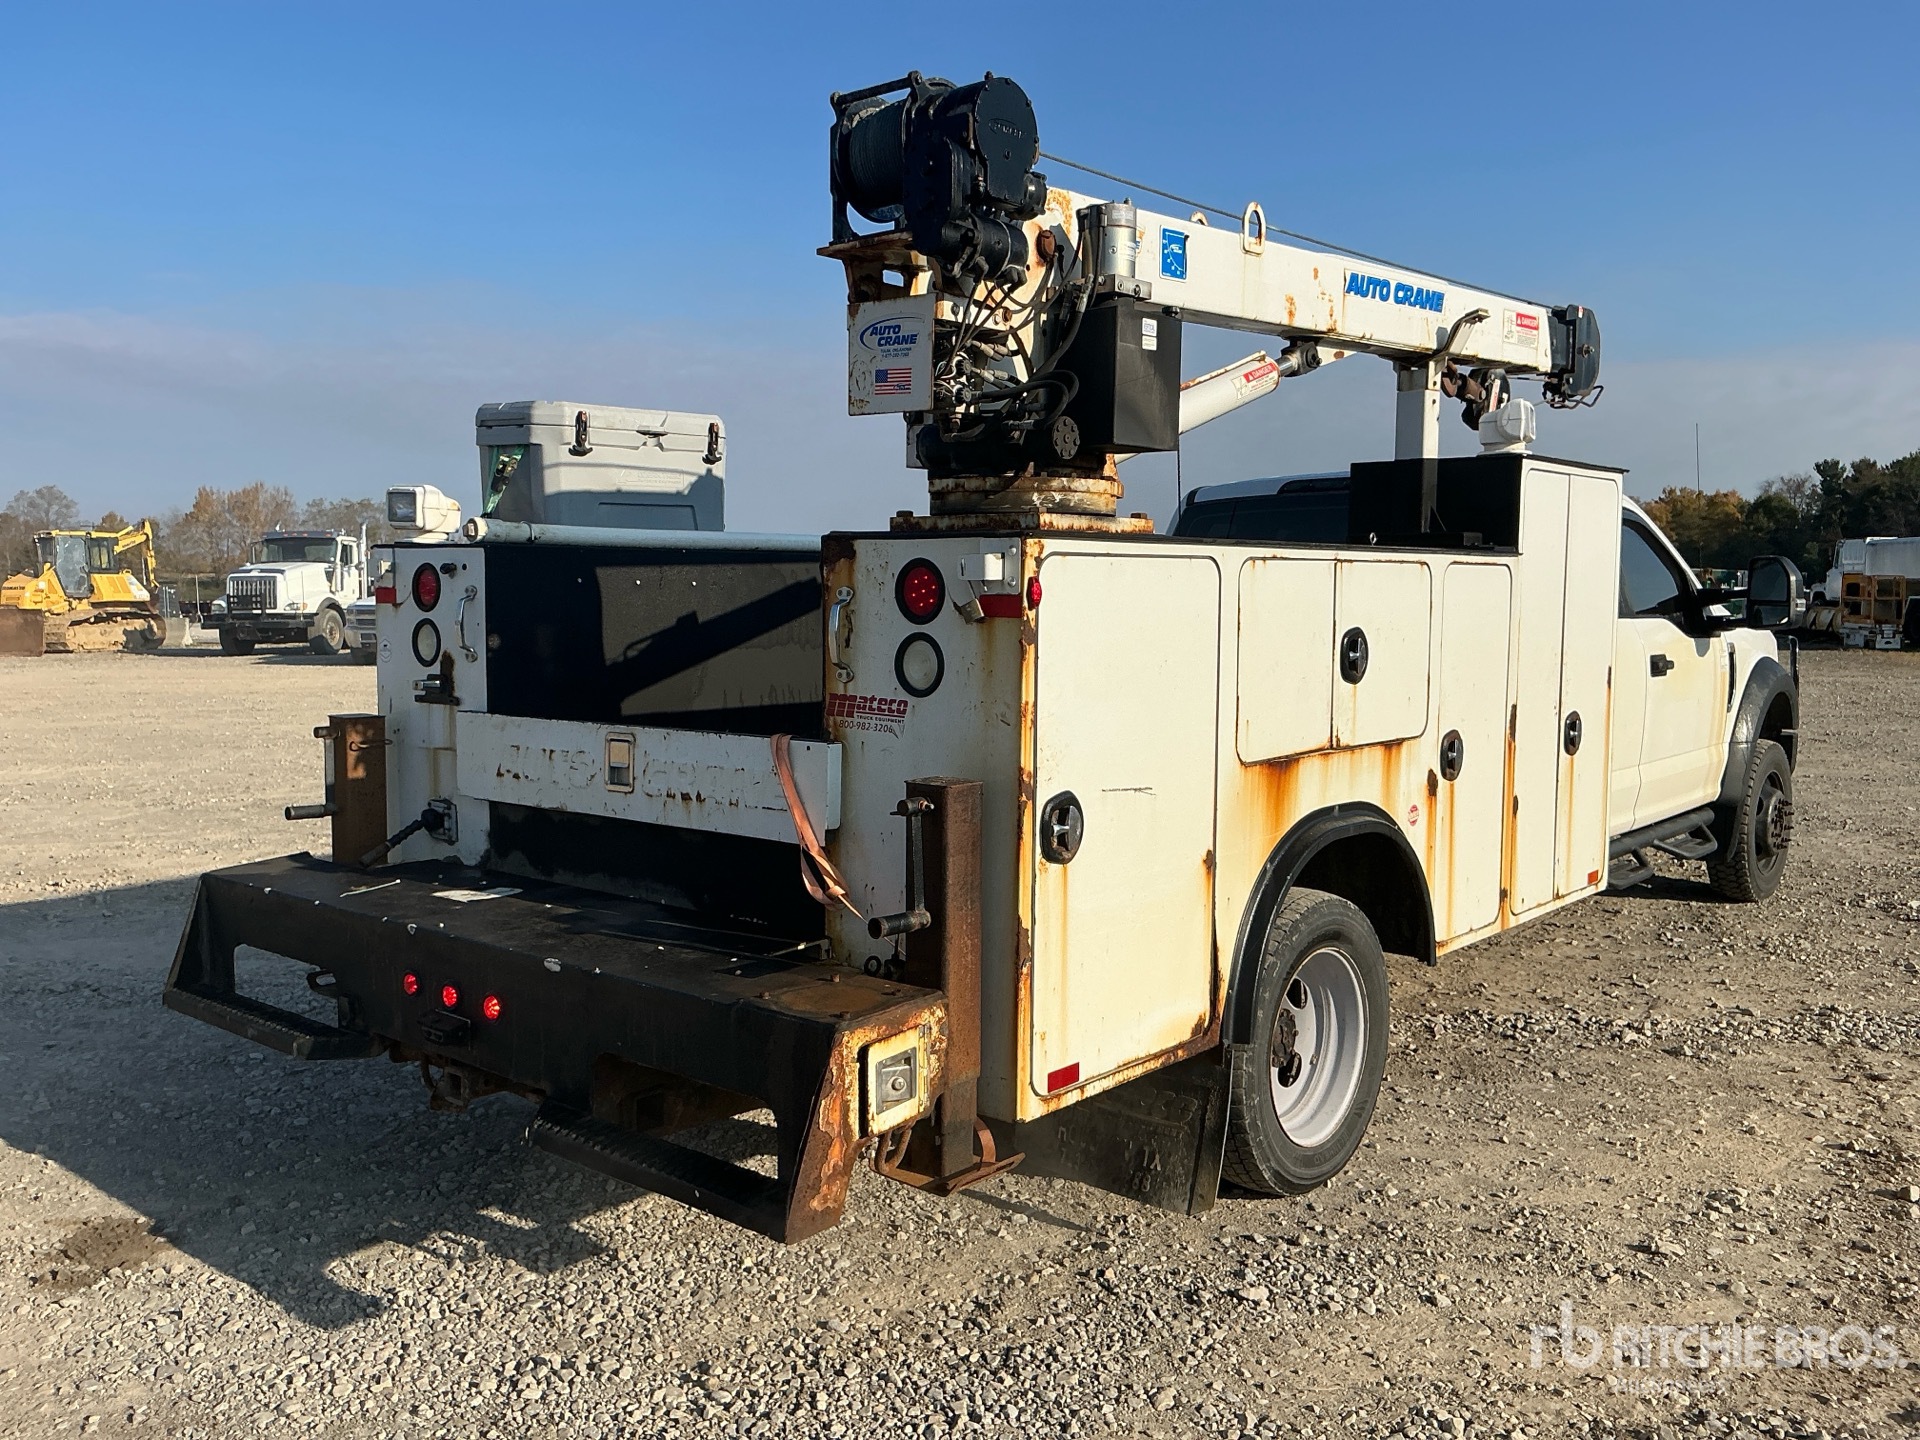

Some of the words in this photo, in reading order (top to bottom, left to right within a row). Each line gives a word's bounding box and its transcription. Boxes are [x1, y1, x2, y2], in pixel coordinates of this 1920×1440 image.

[1346, 272, 1390, 302] AUTO
[1393, 282, 1445, 313] CRANE
[870, 325, 901, 336] AUTO
[878, 335, 917, 347] CRANE
[1252, 365, 1273, 378] DANGER
[826, 692, 909, 718] mateco
[875, 716, 905, 724] EQUIPMENT
